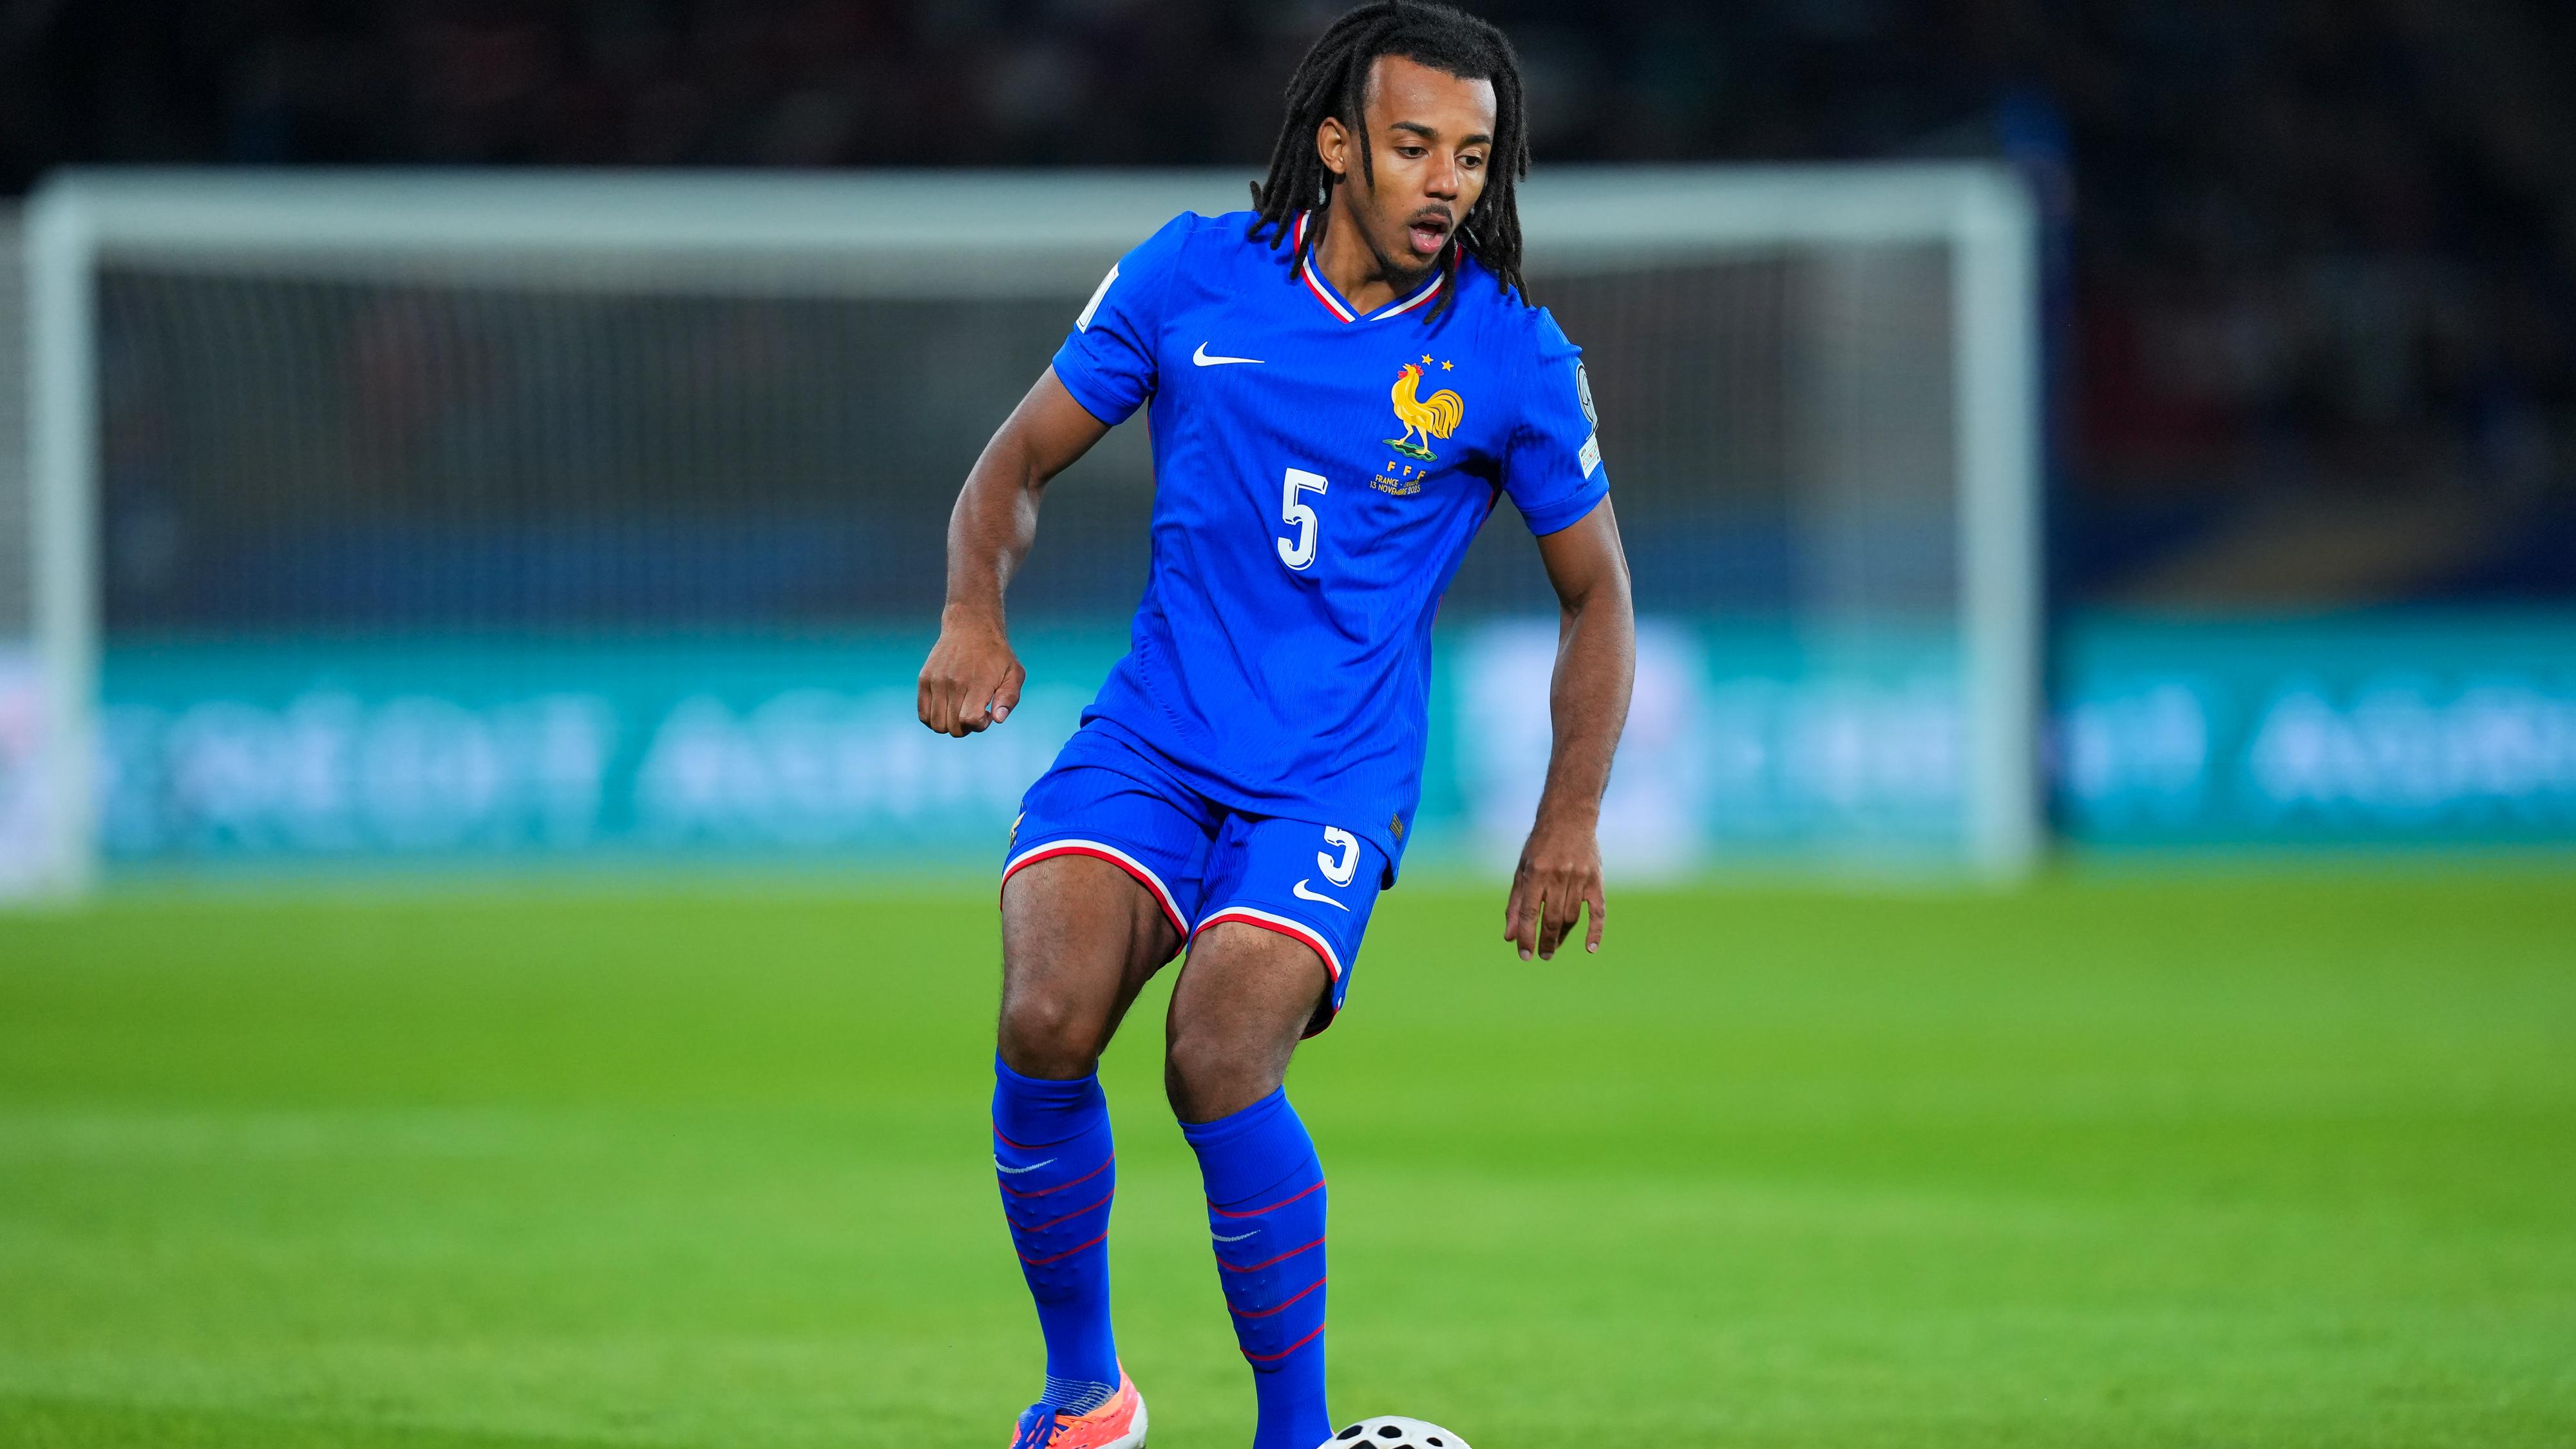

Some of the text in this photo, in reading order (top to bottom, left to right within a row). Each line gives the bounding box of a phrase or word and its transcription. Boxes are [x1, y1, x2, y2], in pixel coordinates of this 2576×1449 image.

[1387, 461, 1396, 471] F
[1403, 465, 1412, 476] F
[1370, 480, 1377, 489] 13
[1407, 484, 1421, 495] 2025
[1375, 474, 1399, 488] FRANCE
[1278, 468, 1329, 571] 5
